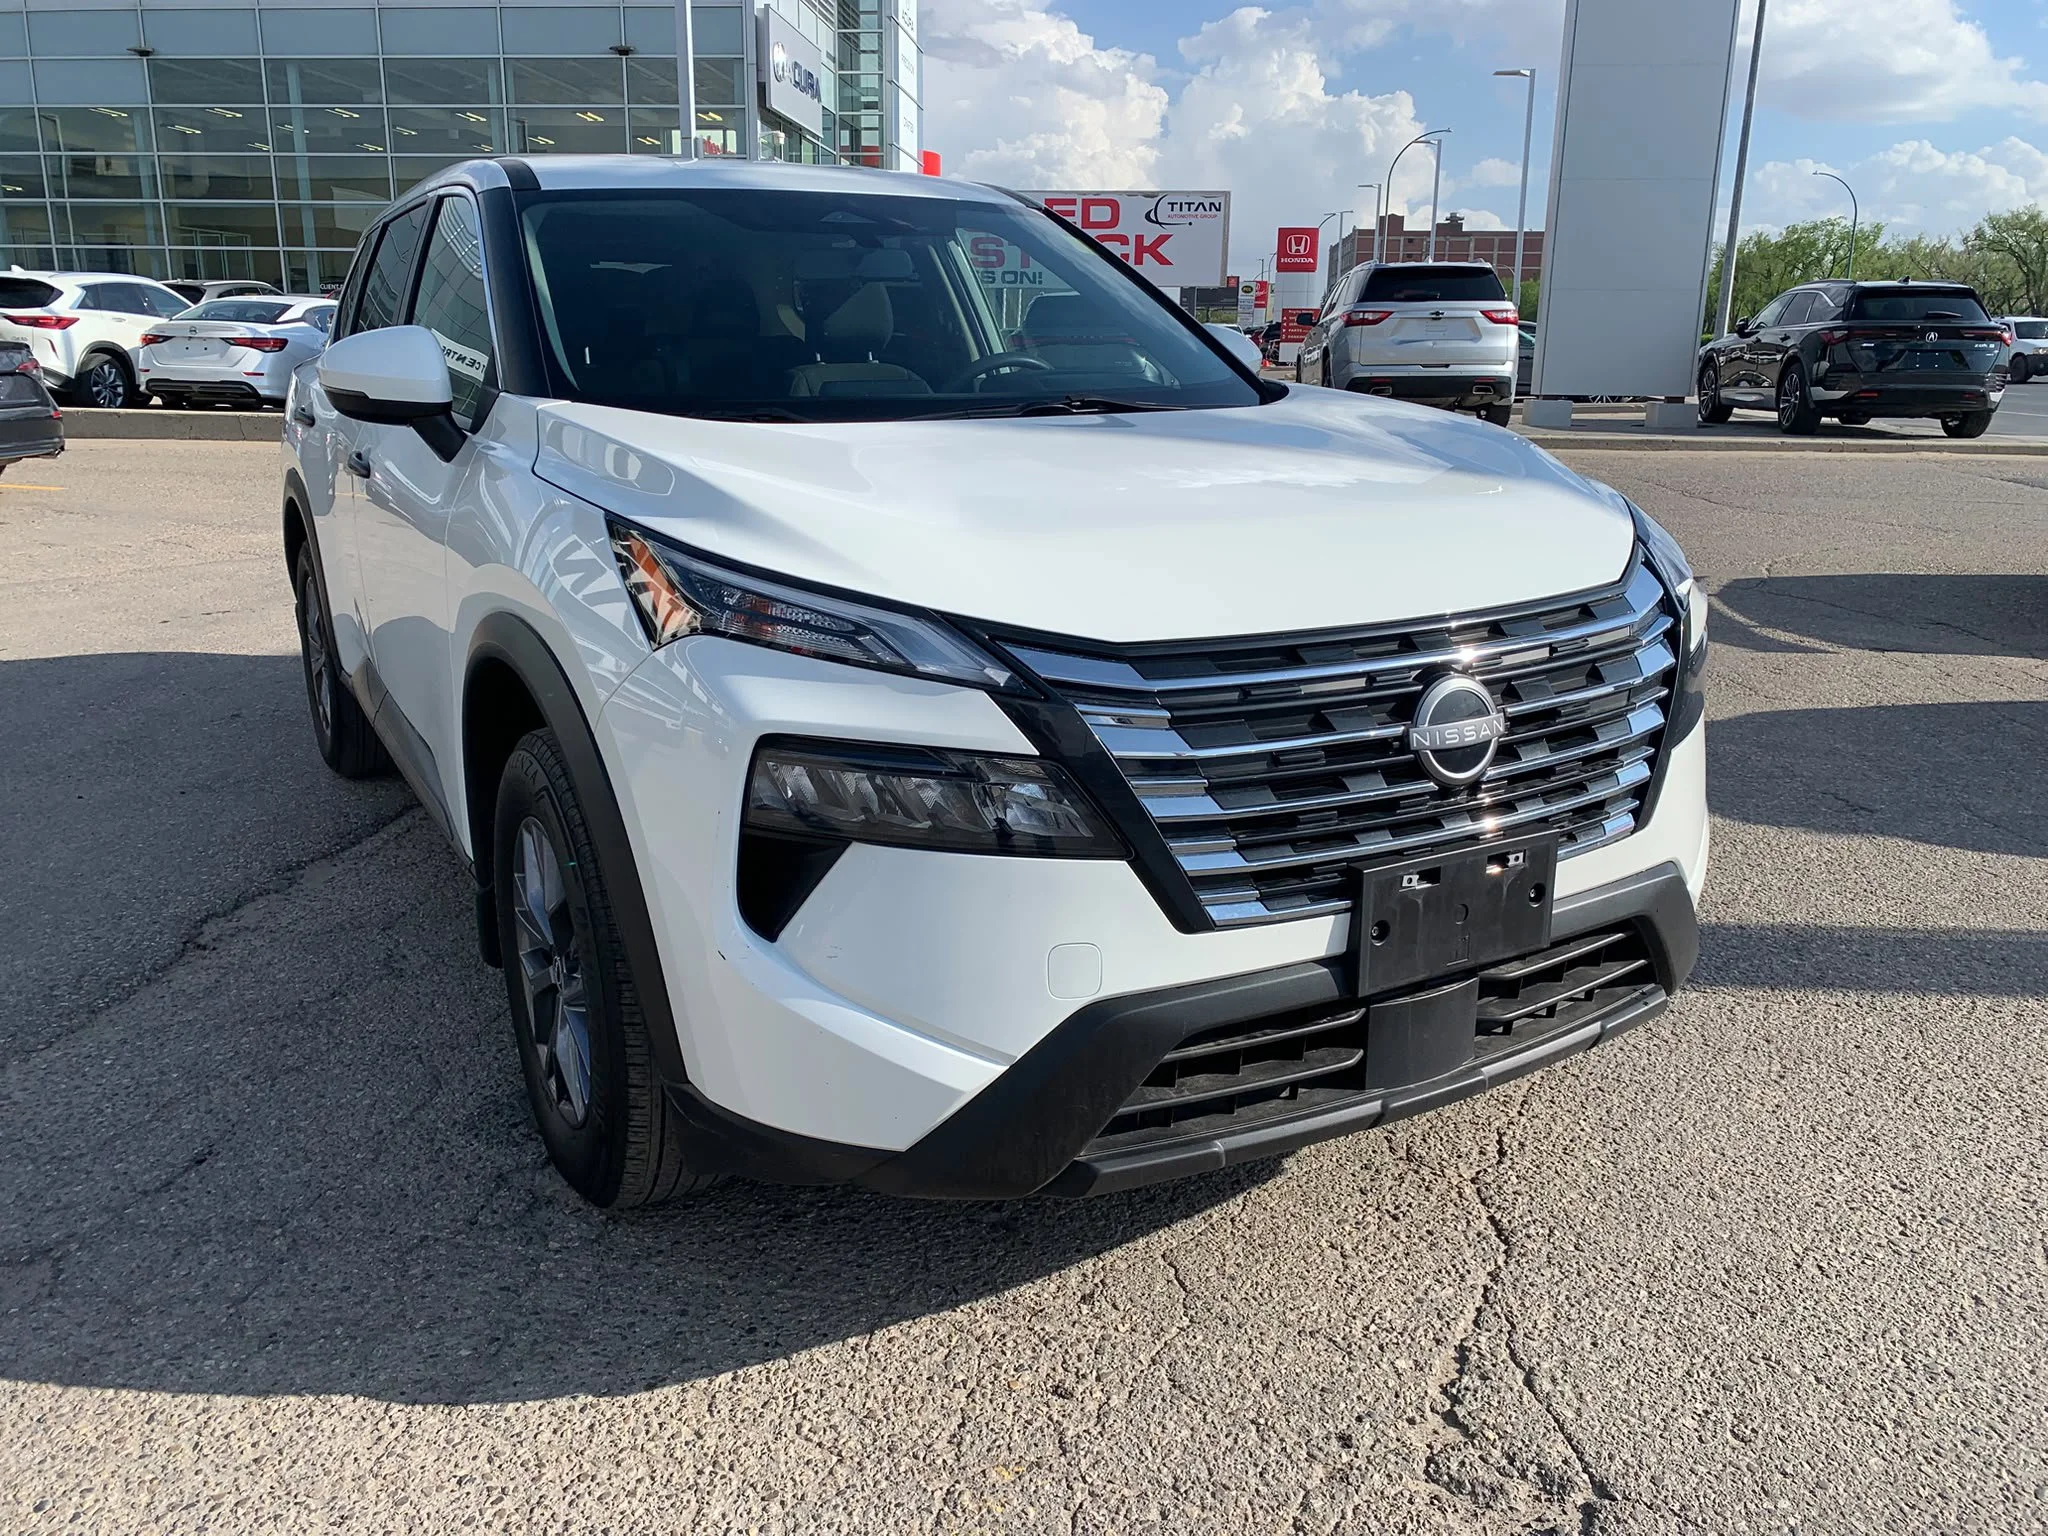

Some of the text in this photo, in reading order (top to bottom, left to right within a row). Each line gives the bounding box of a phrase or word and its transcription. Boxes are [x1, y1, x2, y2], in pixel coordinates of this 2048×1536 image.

[1044, 198, 1120, 229] ED
[1167, 202, 1222, 212] TITAN
[1000, 269, 1043, 285] ON!
[1413, 717, 1504, 747] NISSAN
